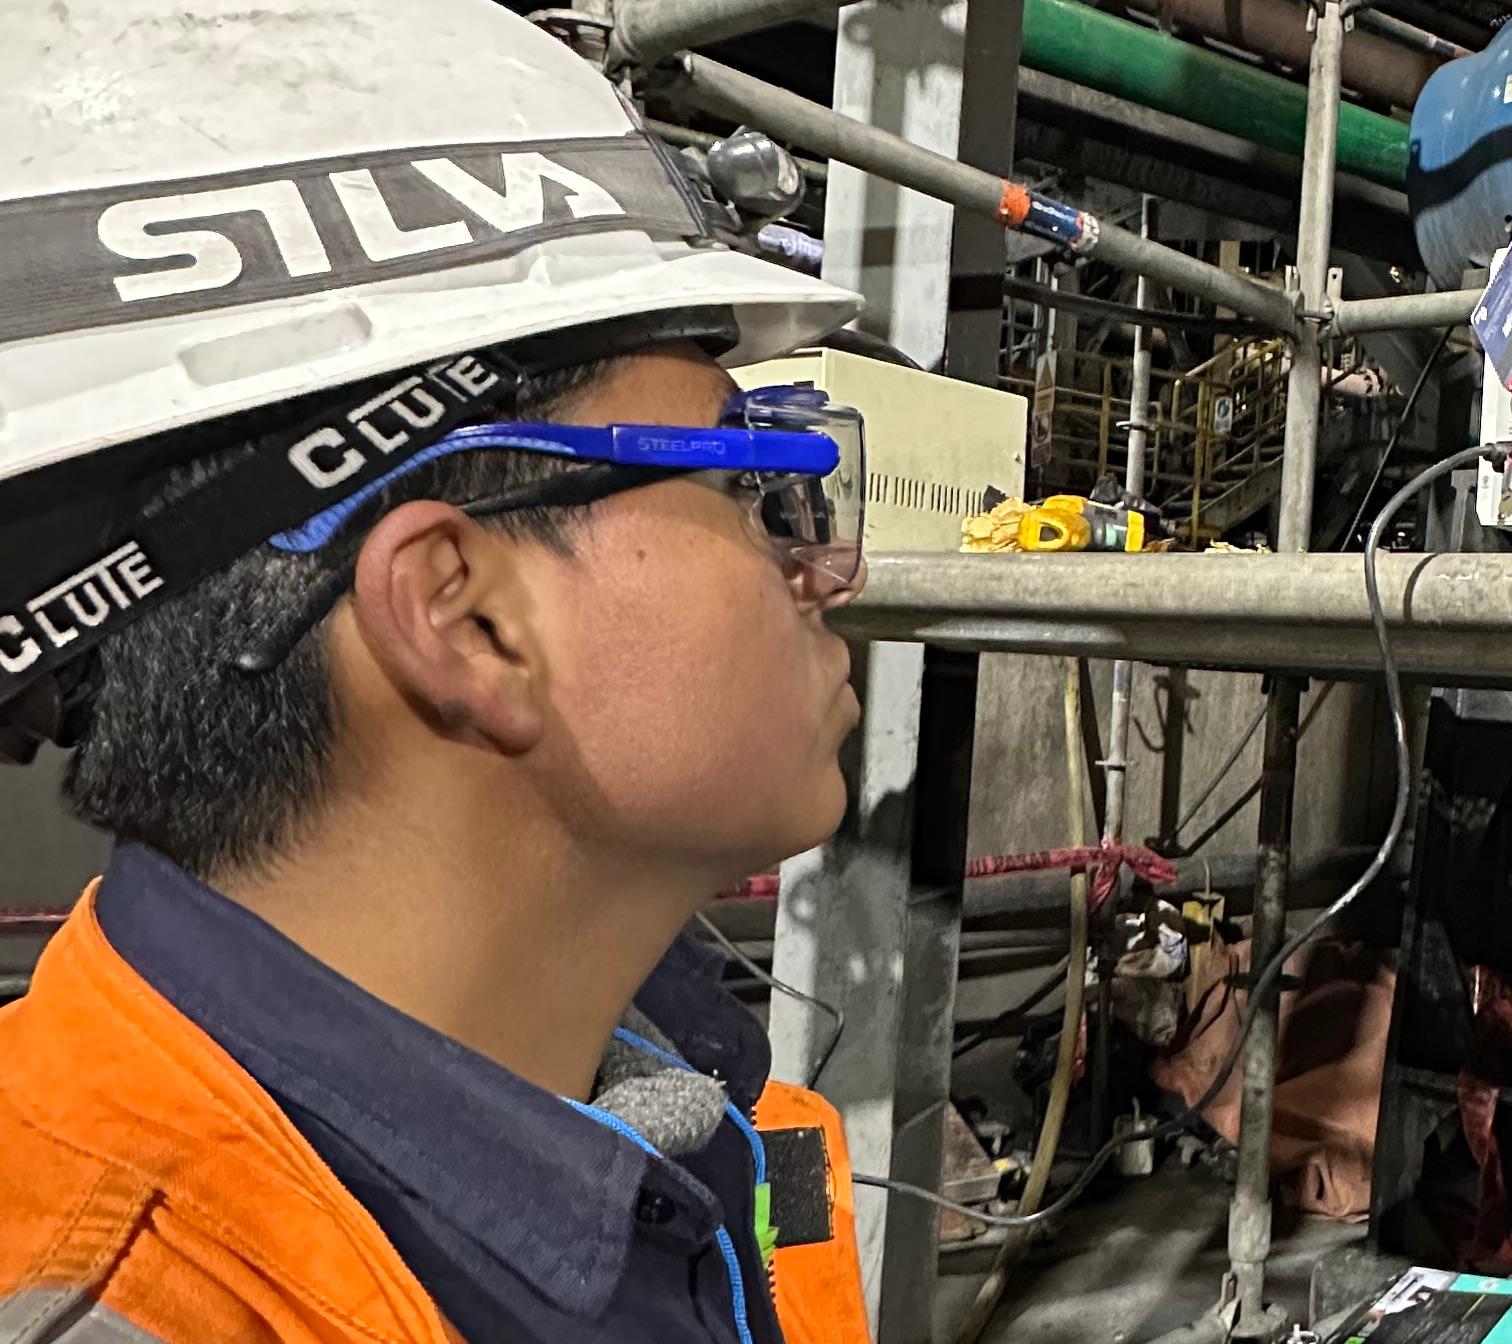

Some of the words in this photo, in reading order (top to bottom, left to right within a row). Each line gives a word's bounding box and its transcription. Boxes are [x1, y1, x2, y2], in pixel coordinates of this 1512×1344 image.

[97, 152, 627, 303] SILVA
[287, 351, 499, 490] CLUTE
[0, 540, 164, 675] CLUTE
